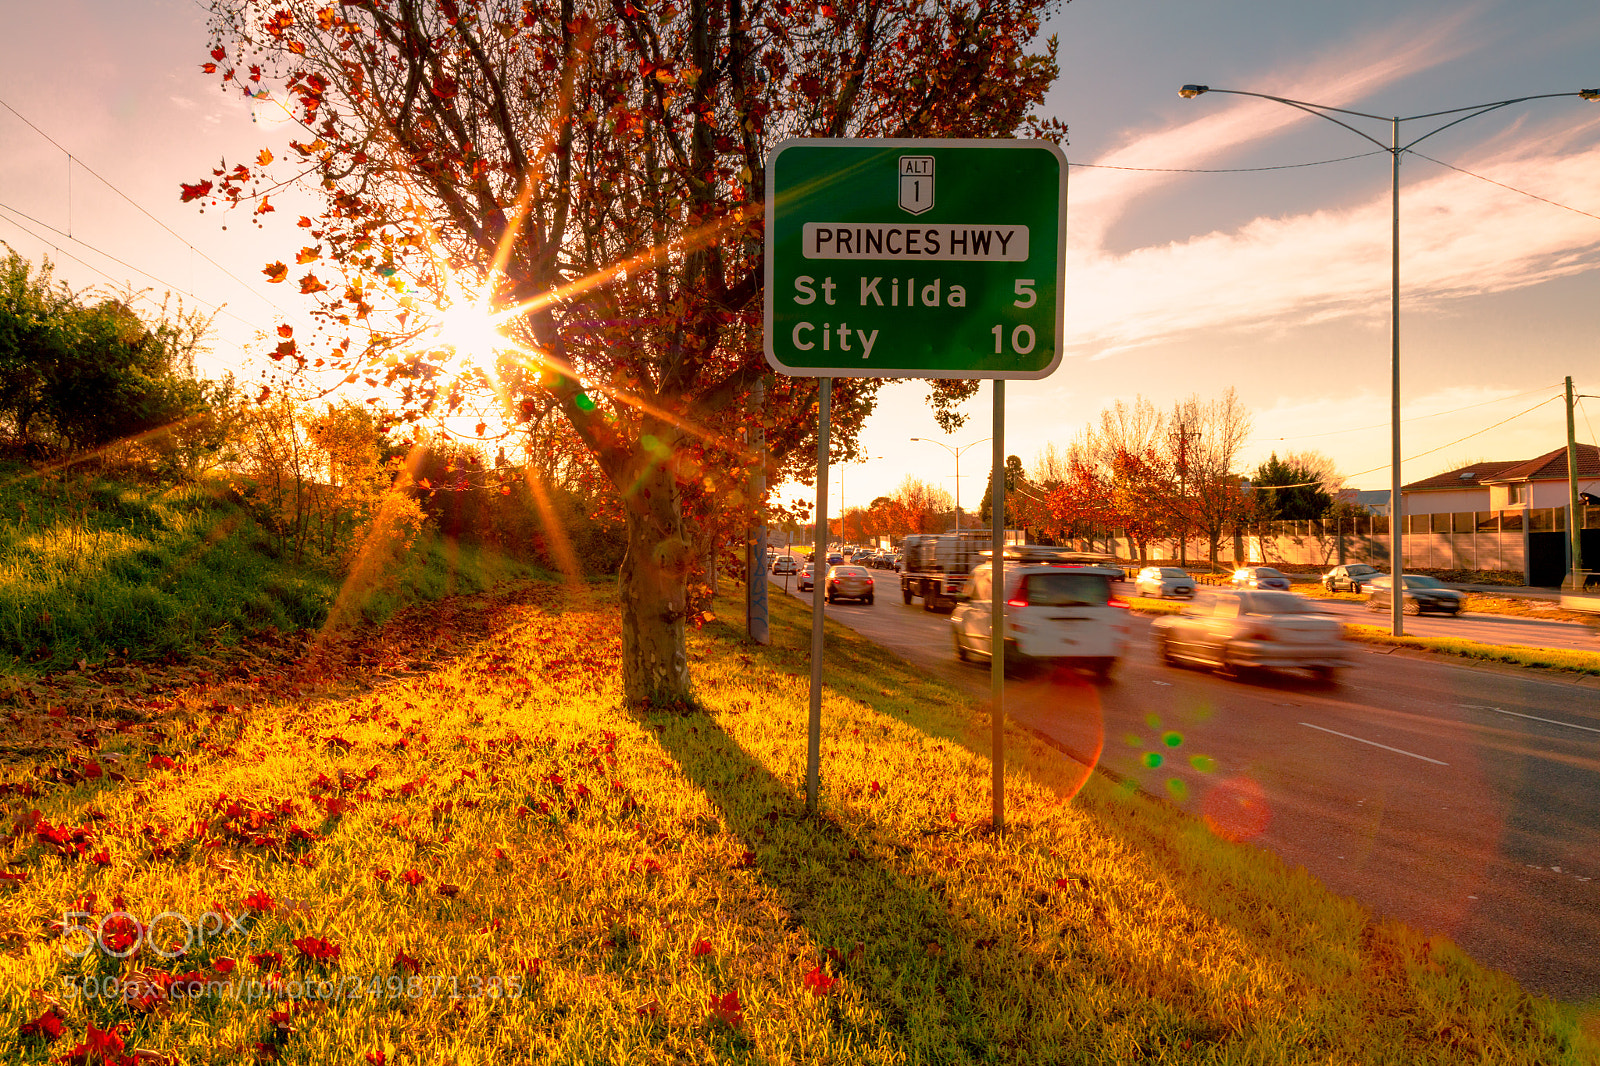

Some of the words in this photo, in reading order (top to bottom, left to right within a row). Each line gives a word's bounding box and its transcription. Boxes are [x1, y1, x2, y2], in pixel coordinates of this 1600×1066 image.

[905, 160, 929, 174] ALT
[913, 180, 920, 202] 1
[816, 228, 941, 255] PRINCES
[950, 230, 1015, 256] HWY
[793, 275, 837, 306] St
[860, 276, 966, 308] Kilda
[1013, 278, 1038, 309] 5
[792, 321, 880, 360] City
[991, 324, 1037, 354] 10
